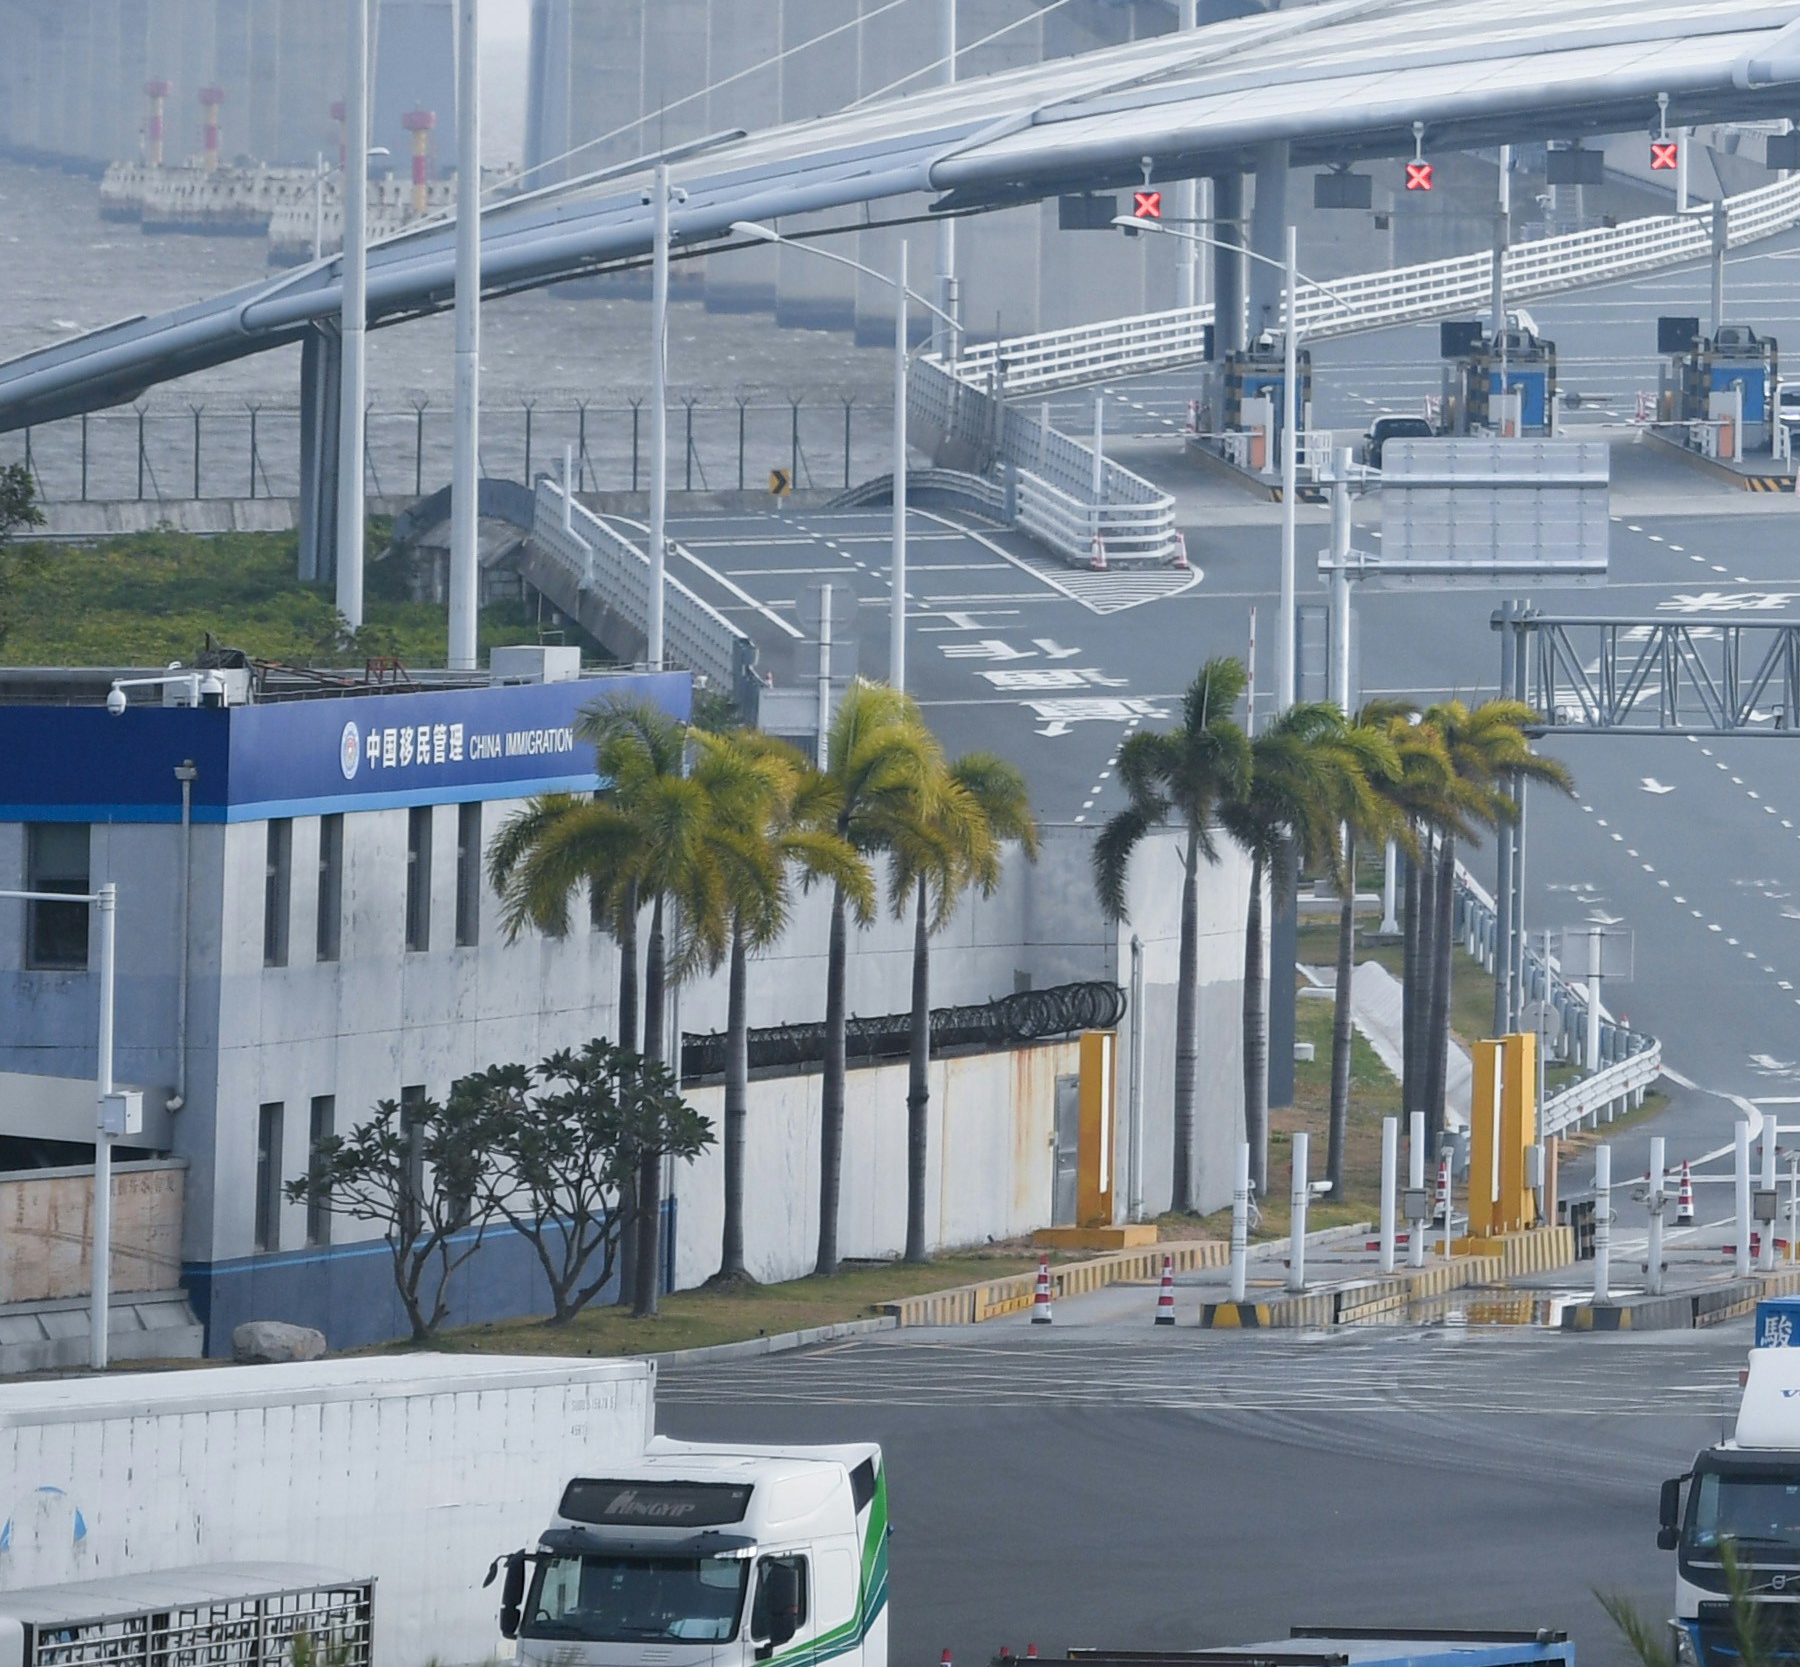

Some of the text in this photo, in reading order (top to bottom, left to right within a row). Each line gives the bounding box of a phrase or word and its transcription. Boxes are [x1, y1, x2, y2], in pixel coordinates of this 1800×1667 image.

[366, 722, 464, 770] 中国移民管理
[470, 727, 574, 760] CHINA IMMIGRATION
